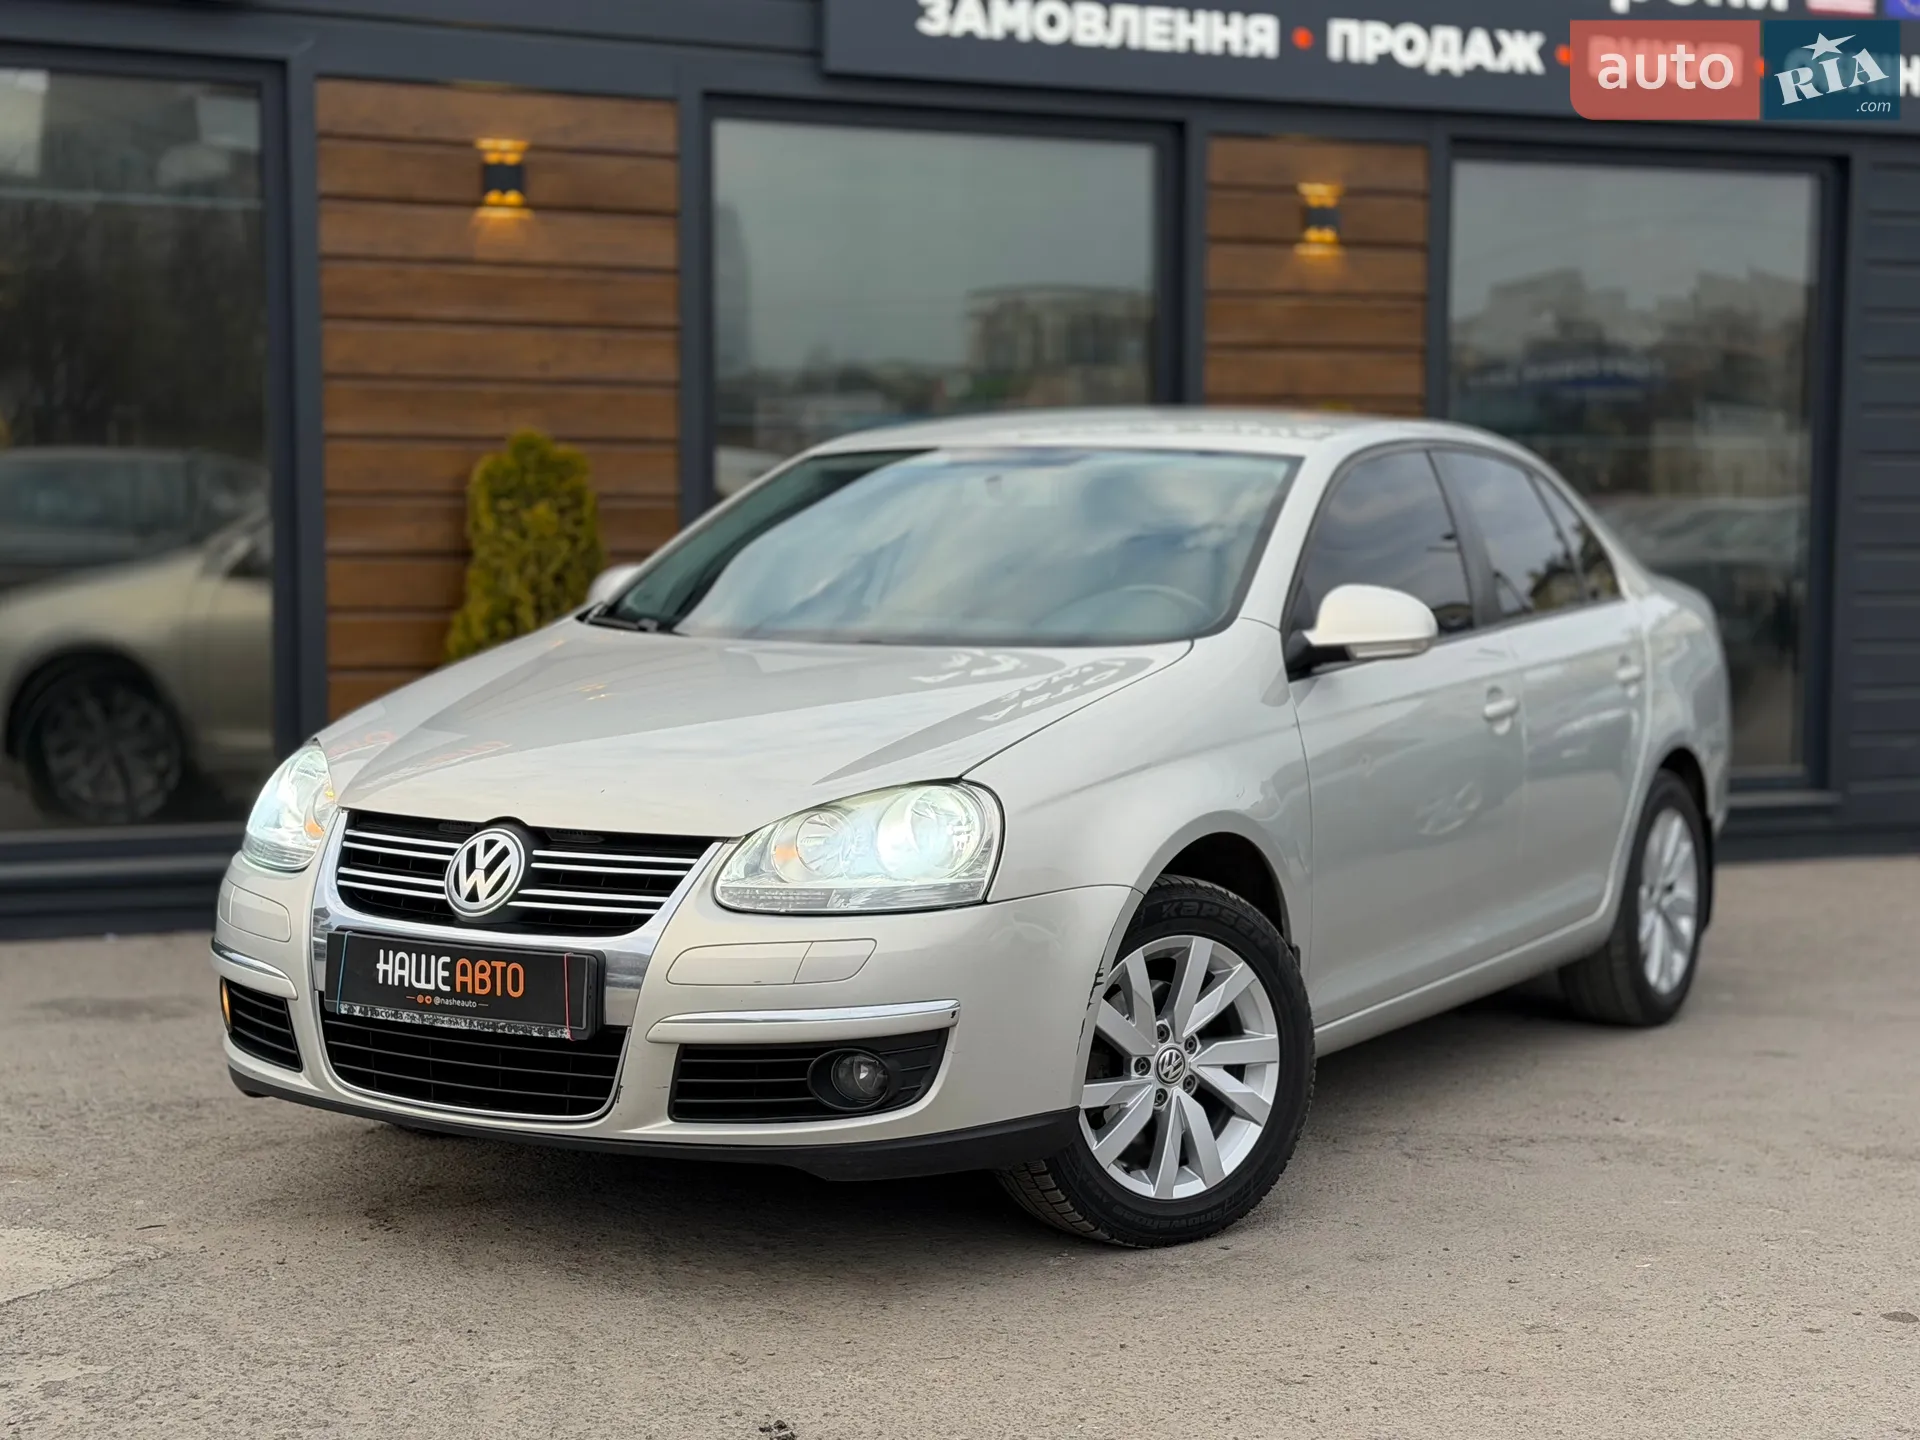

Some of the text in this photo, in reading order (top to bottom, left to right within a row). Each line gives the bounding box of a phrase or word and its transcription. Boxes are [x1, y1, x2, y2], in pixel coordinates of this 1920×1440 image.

[916, 0, 1280, 58] ЗАМОВЛЕННЯ
[1326, 17, 1546, 77] ПРОДАЖ
[376, 949, 524, 998] НАШЕ АВТО
[433, 995, 478, 1008] @nasheauto
